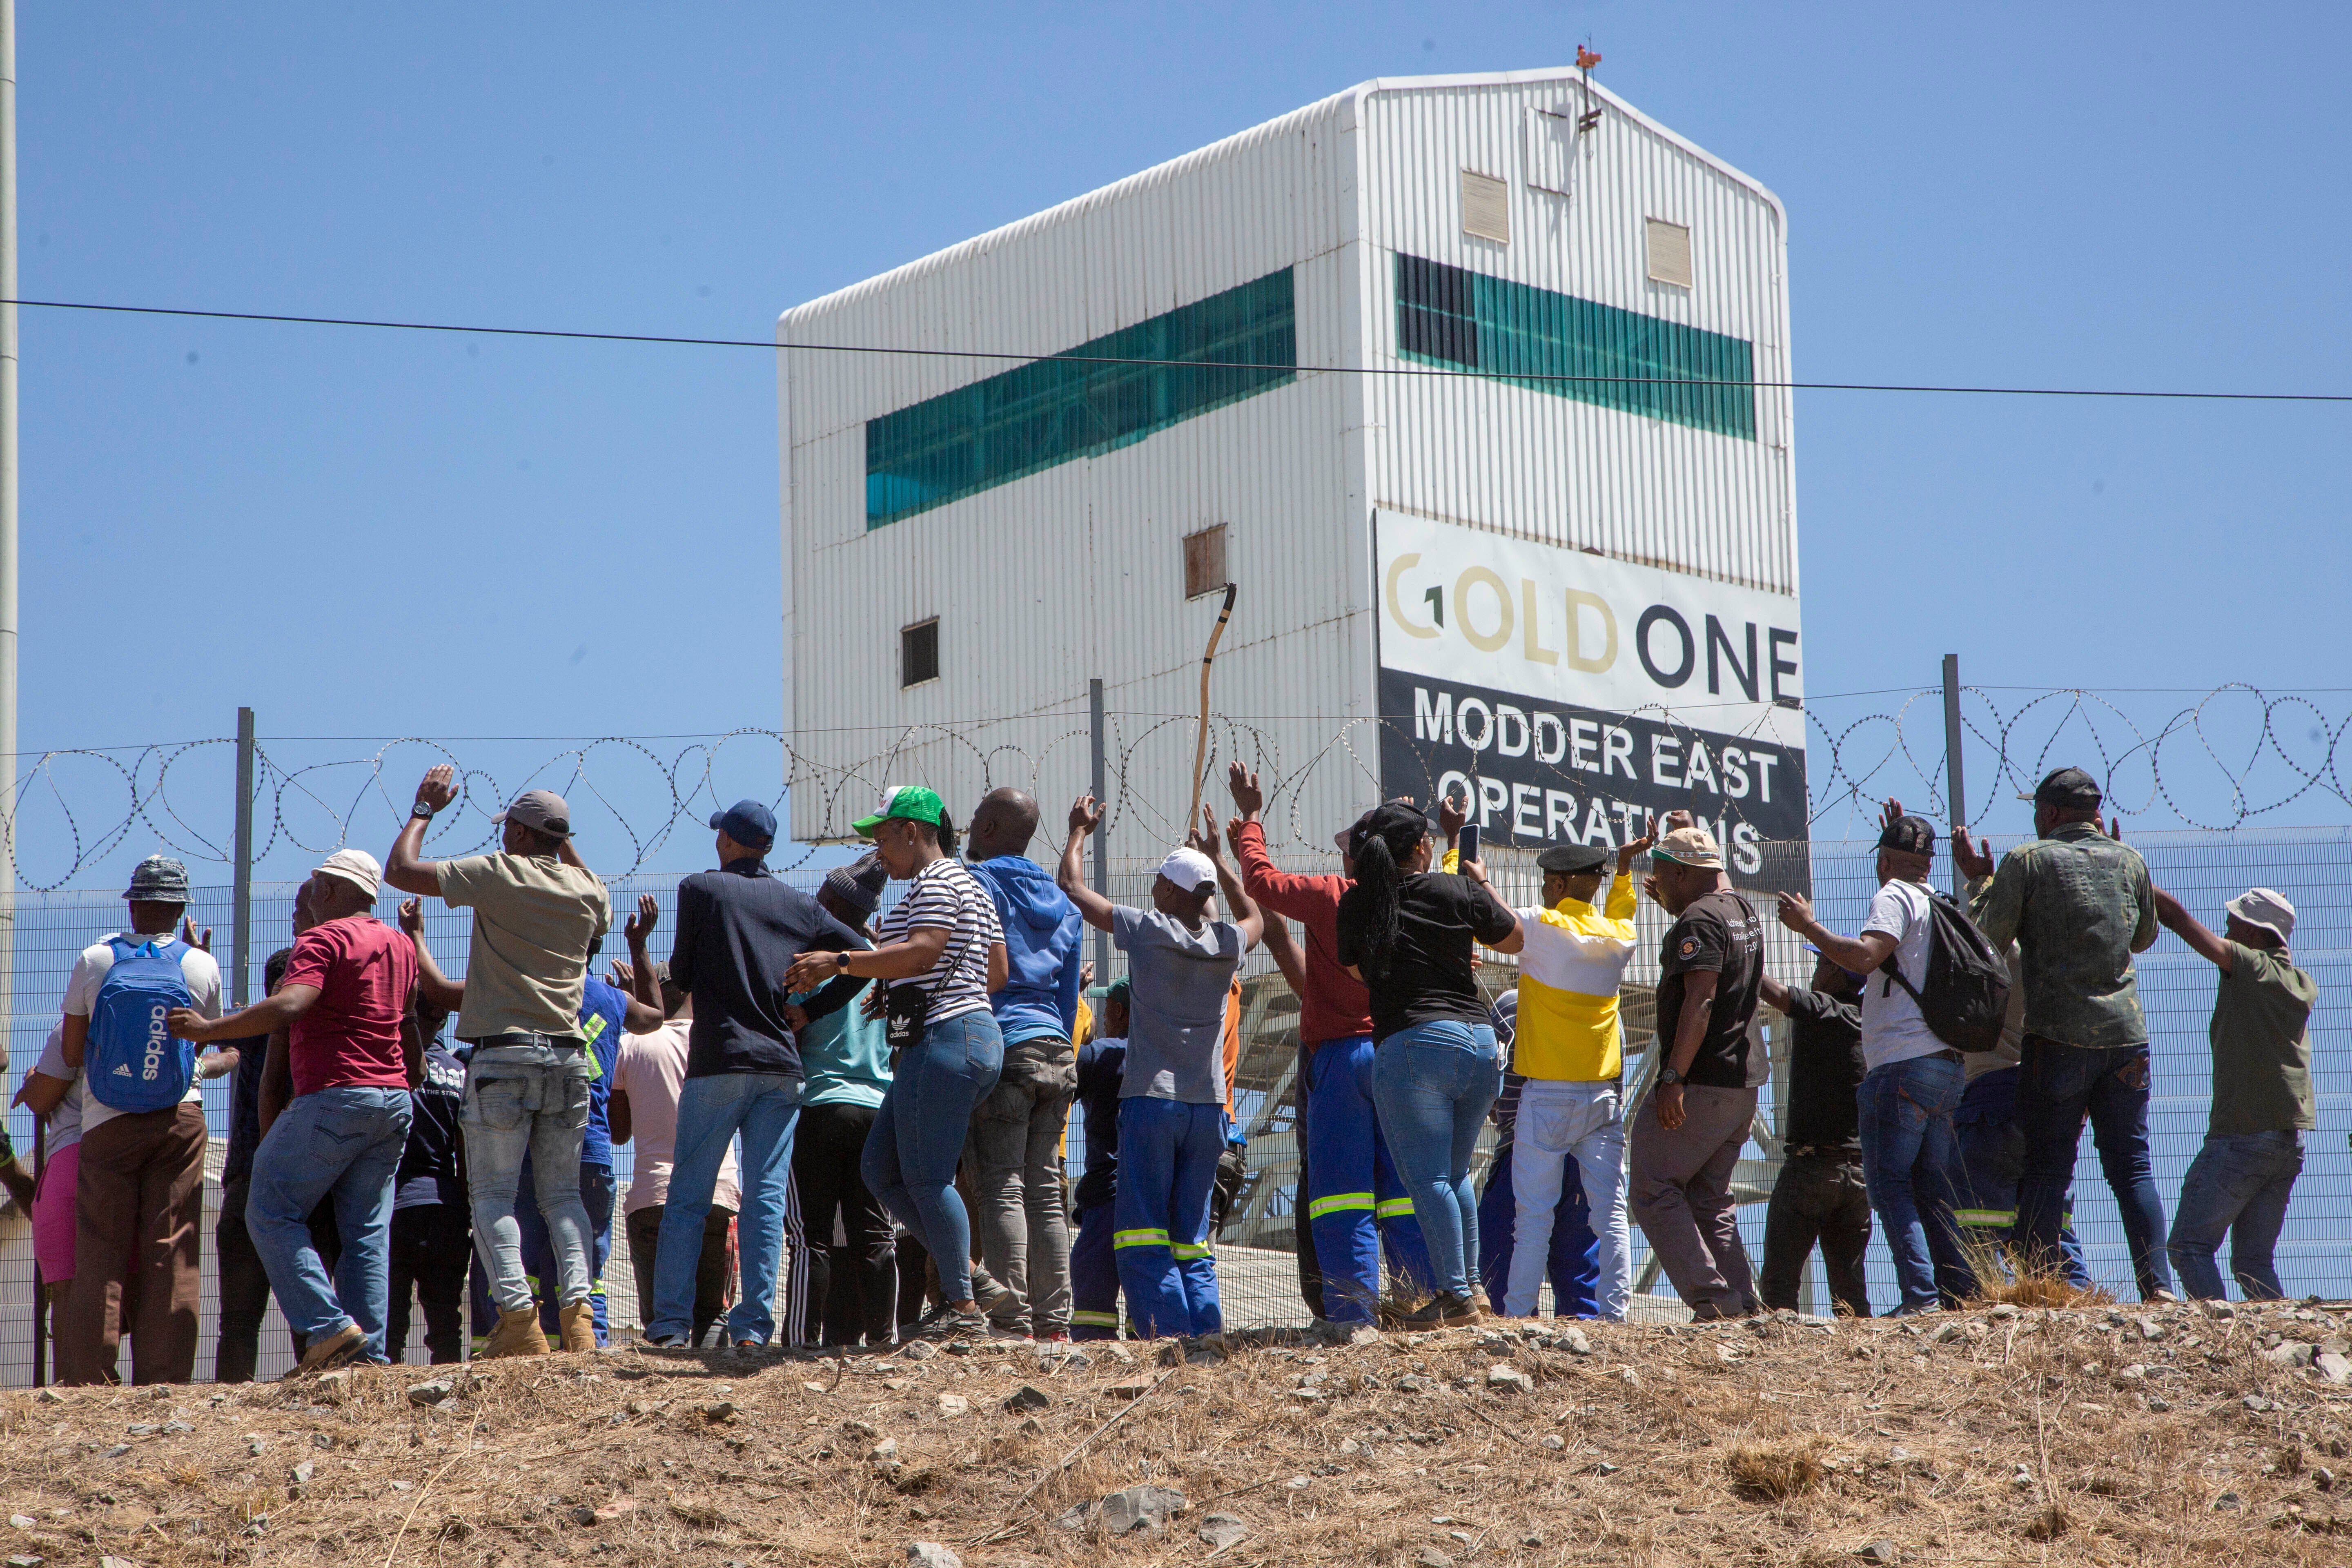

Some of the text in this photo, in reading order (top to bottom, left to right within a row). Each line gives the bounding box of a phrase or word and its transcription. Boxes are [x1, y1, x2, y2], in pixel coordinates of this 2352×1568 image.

[1636, 604, 1798, 710] ONE
[1414, 687, 1779, 803] MODDER EAST
[939, 968, 953, 988] adidas
[142, 1005, 167, 1080] adidas
[441, 1090, 460, 1098] STREE
